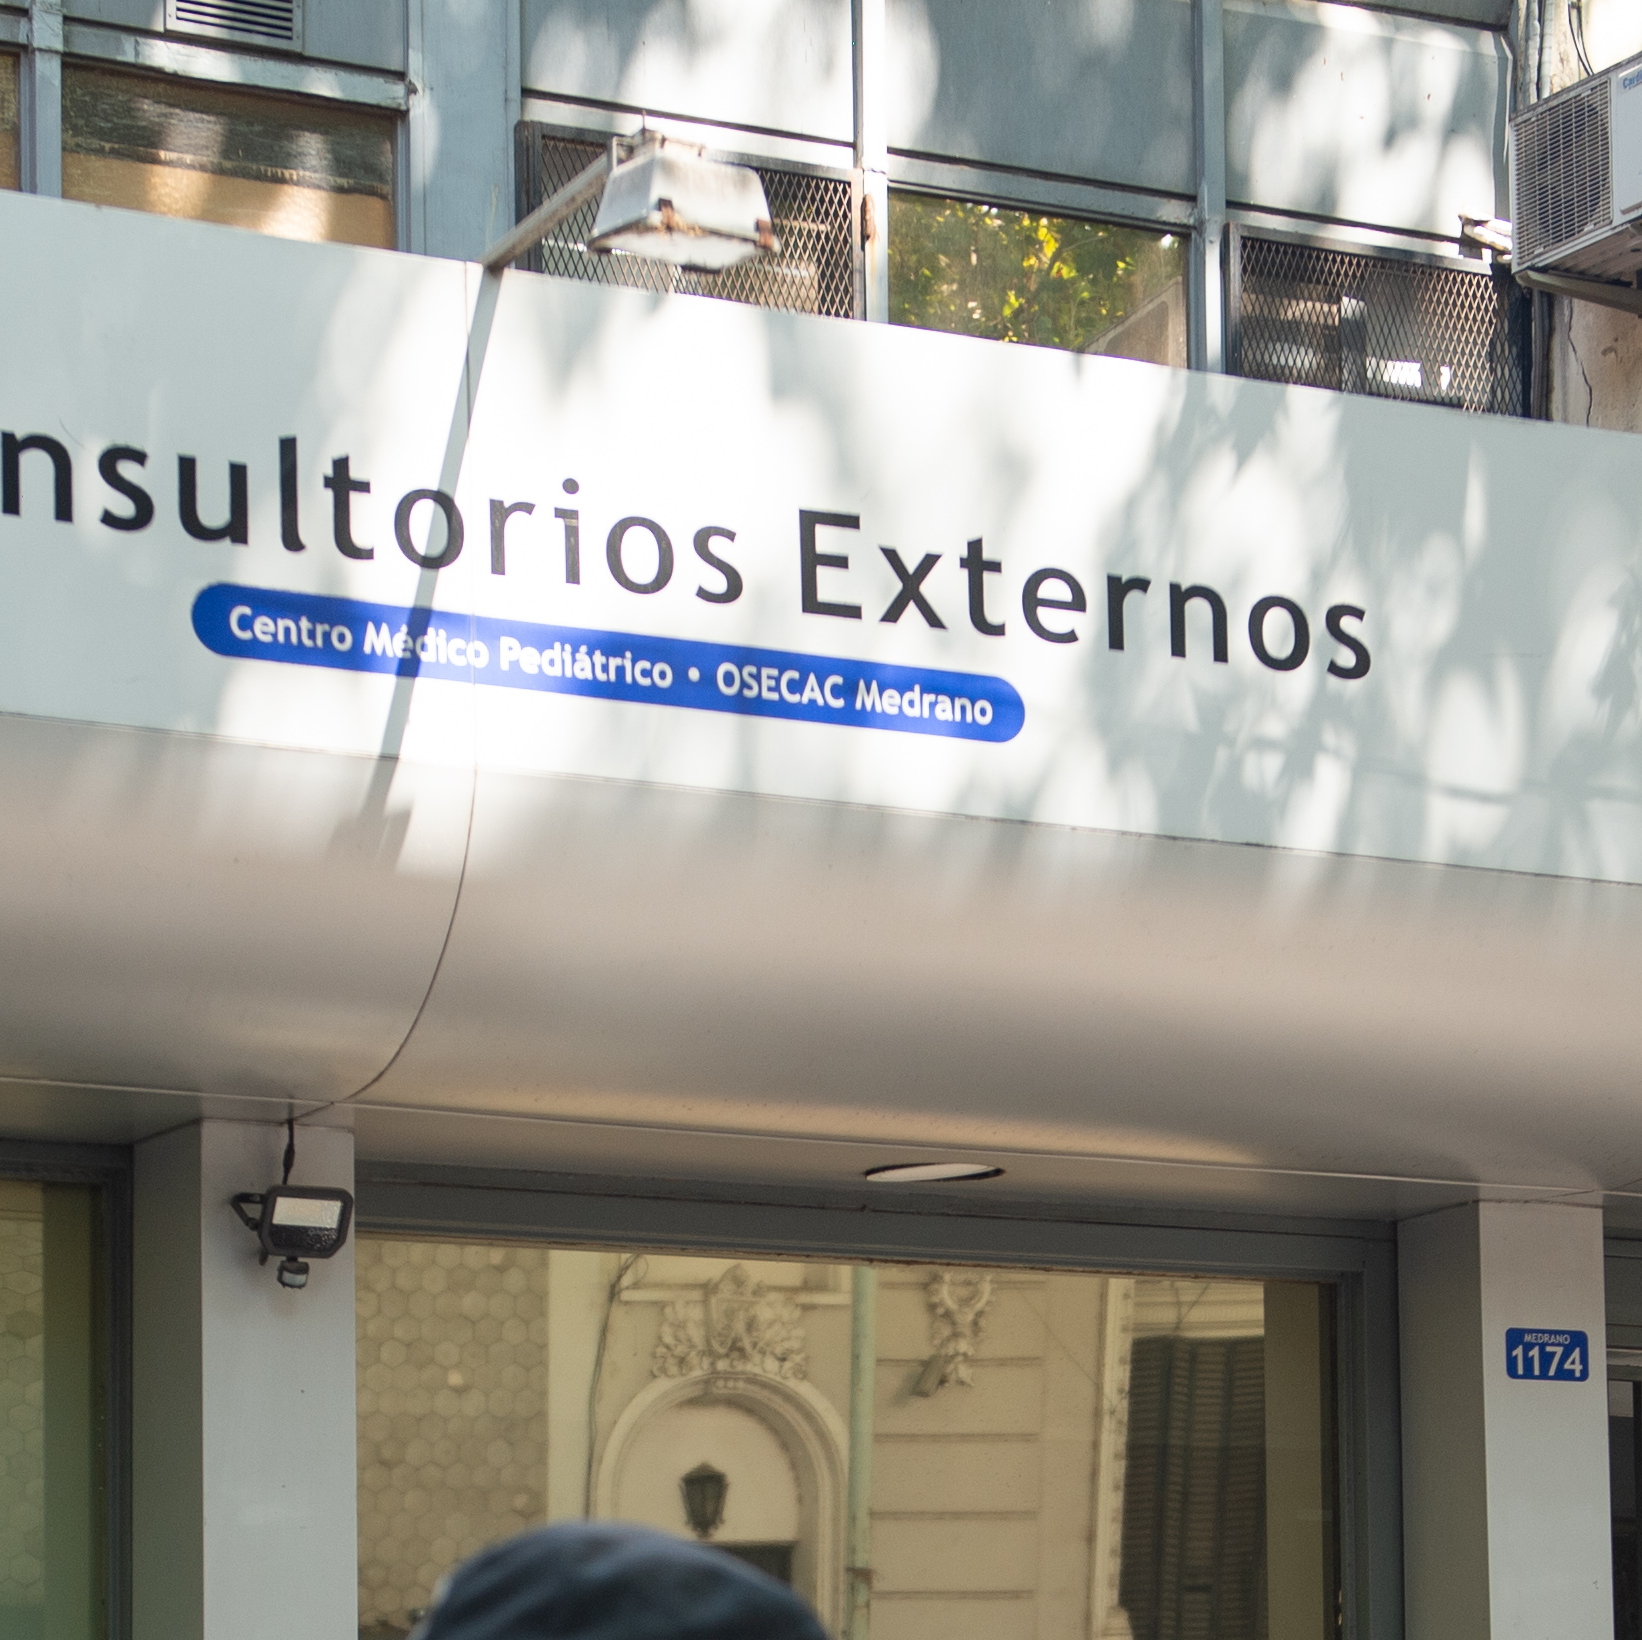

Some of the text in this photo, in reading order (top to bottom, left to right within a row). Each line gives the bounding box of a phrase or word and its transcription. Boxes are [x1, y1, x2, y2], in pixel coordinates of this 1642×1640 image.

[799, 509, 1372, 681] Externos
[229, 605, 994, 726] Centro Médico Pediátrico OSECAC Medrano
[1511, 1344, 1583, 1378] 1174
[1523, 1332, 1571, 1345] MEDRANO
